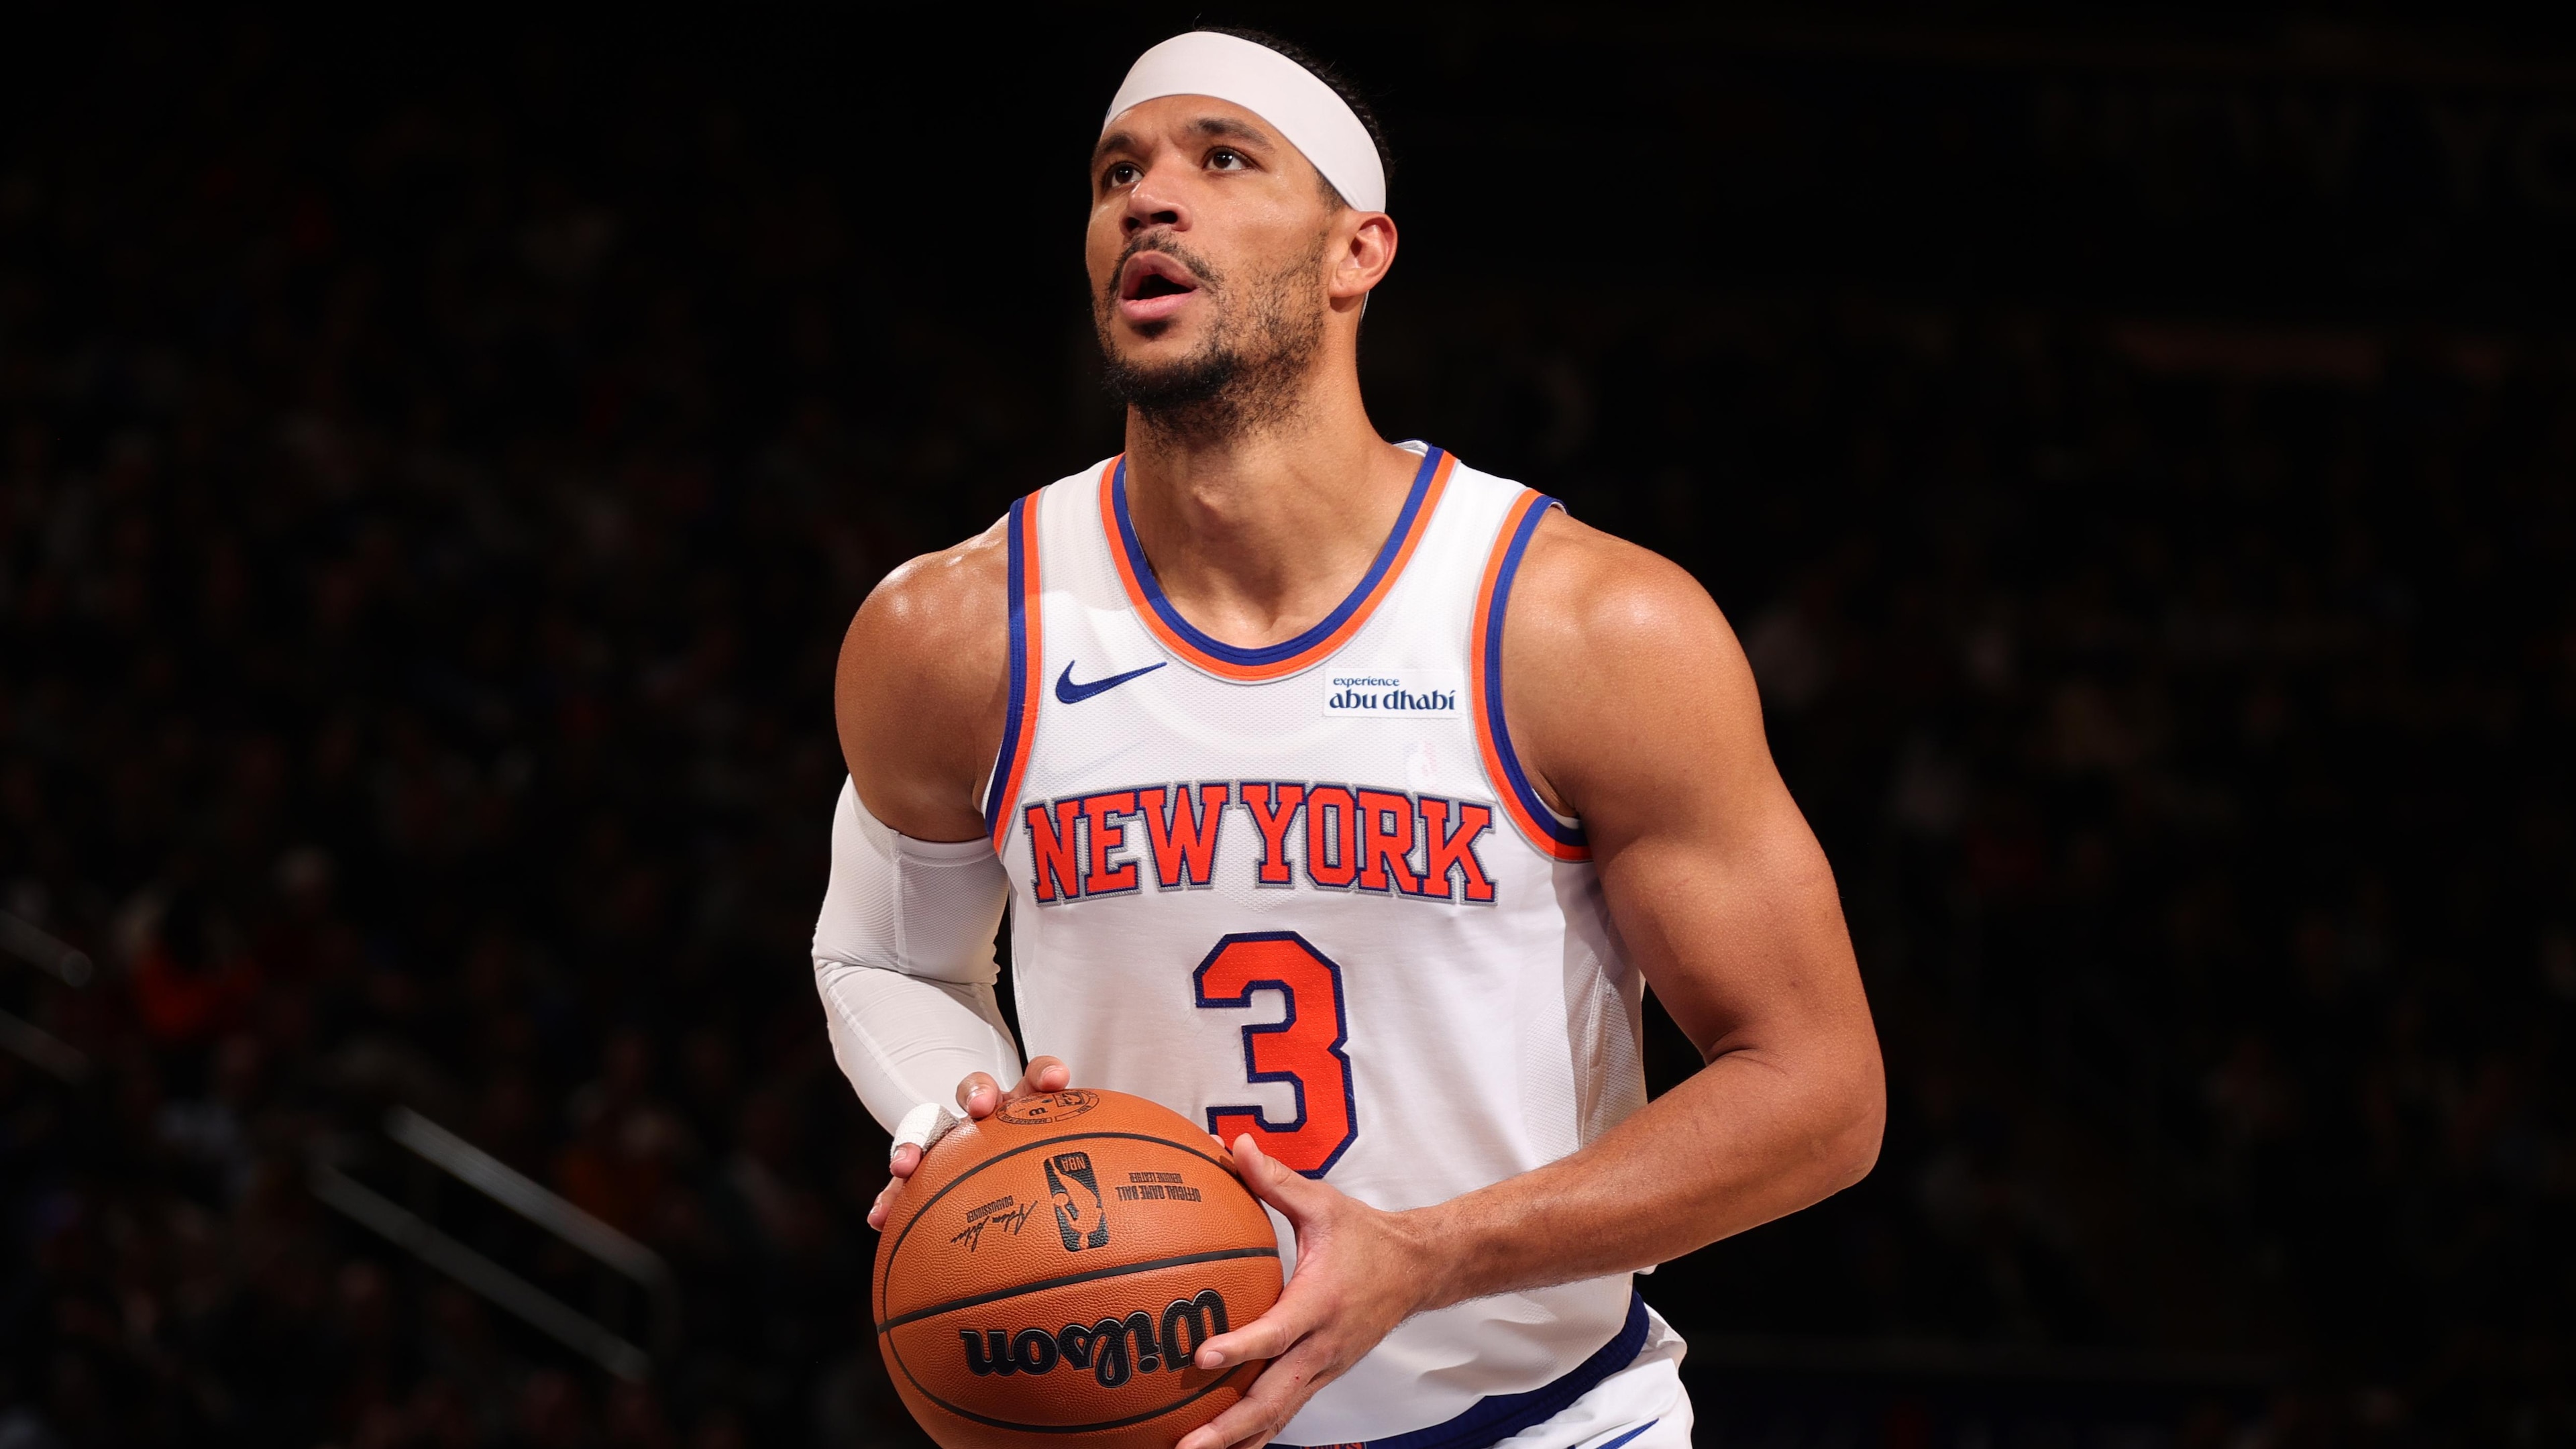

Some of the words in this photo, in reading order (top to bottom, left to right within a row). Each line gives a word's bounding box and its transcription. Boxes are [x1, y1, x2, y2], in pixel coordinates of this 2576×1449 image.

[1332, 676, 1401, 688] experience
[1329, 688, 1377, 709] abu
[1383, 689, 1456, 710] dhabi
[1023, 779, 1234, 906] NEW
[1236, 778, 1498, 906] YORK
[1193, 930, 1359, 1180] 3
[1061, 1155, 1086, 1172] NBA
[1128, 1171, 1157, 1184] LEATHER
[1115, 1185, 1139, 1201] BALL
[1138, 1185, 1166, 1200] GAME
[1164, 1185, 1202, 1203] OFFICIAL
[965, 1195, 1014, 1224] COMMISSIONER
[959, 1289, 1229, 1389] Wilson
